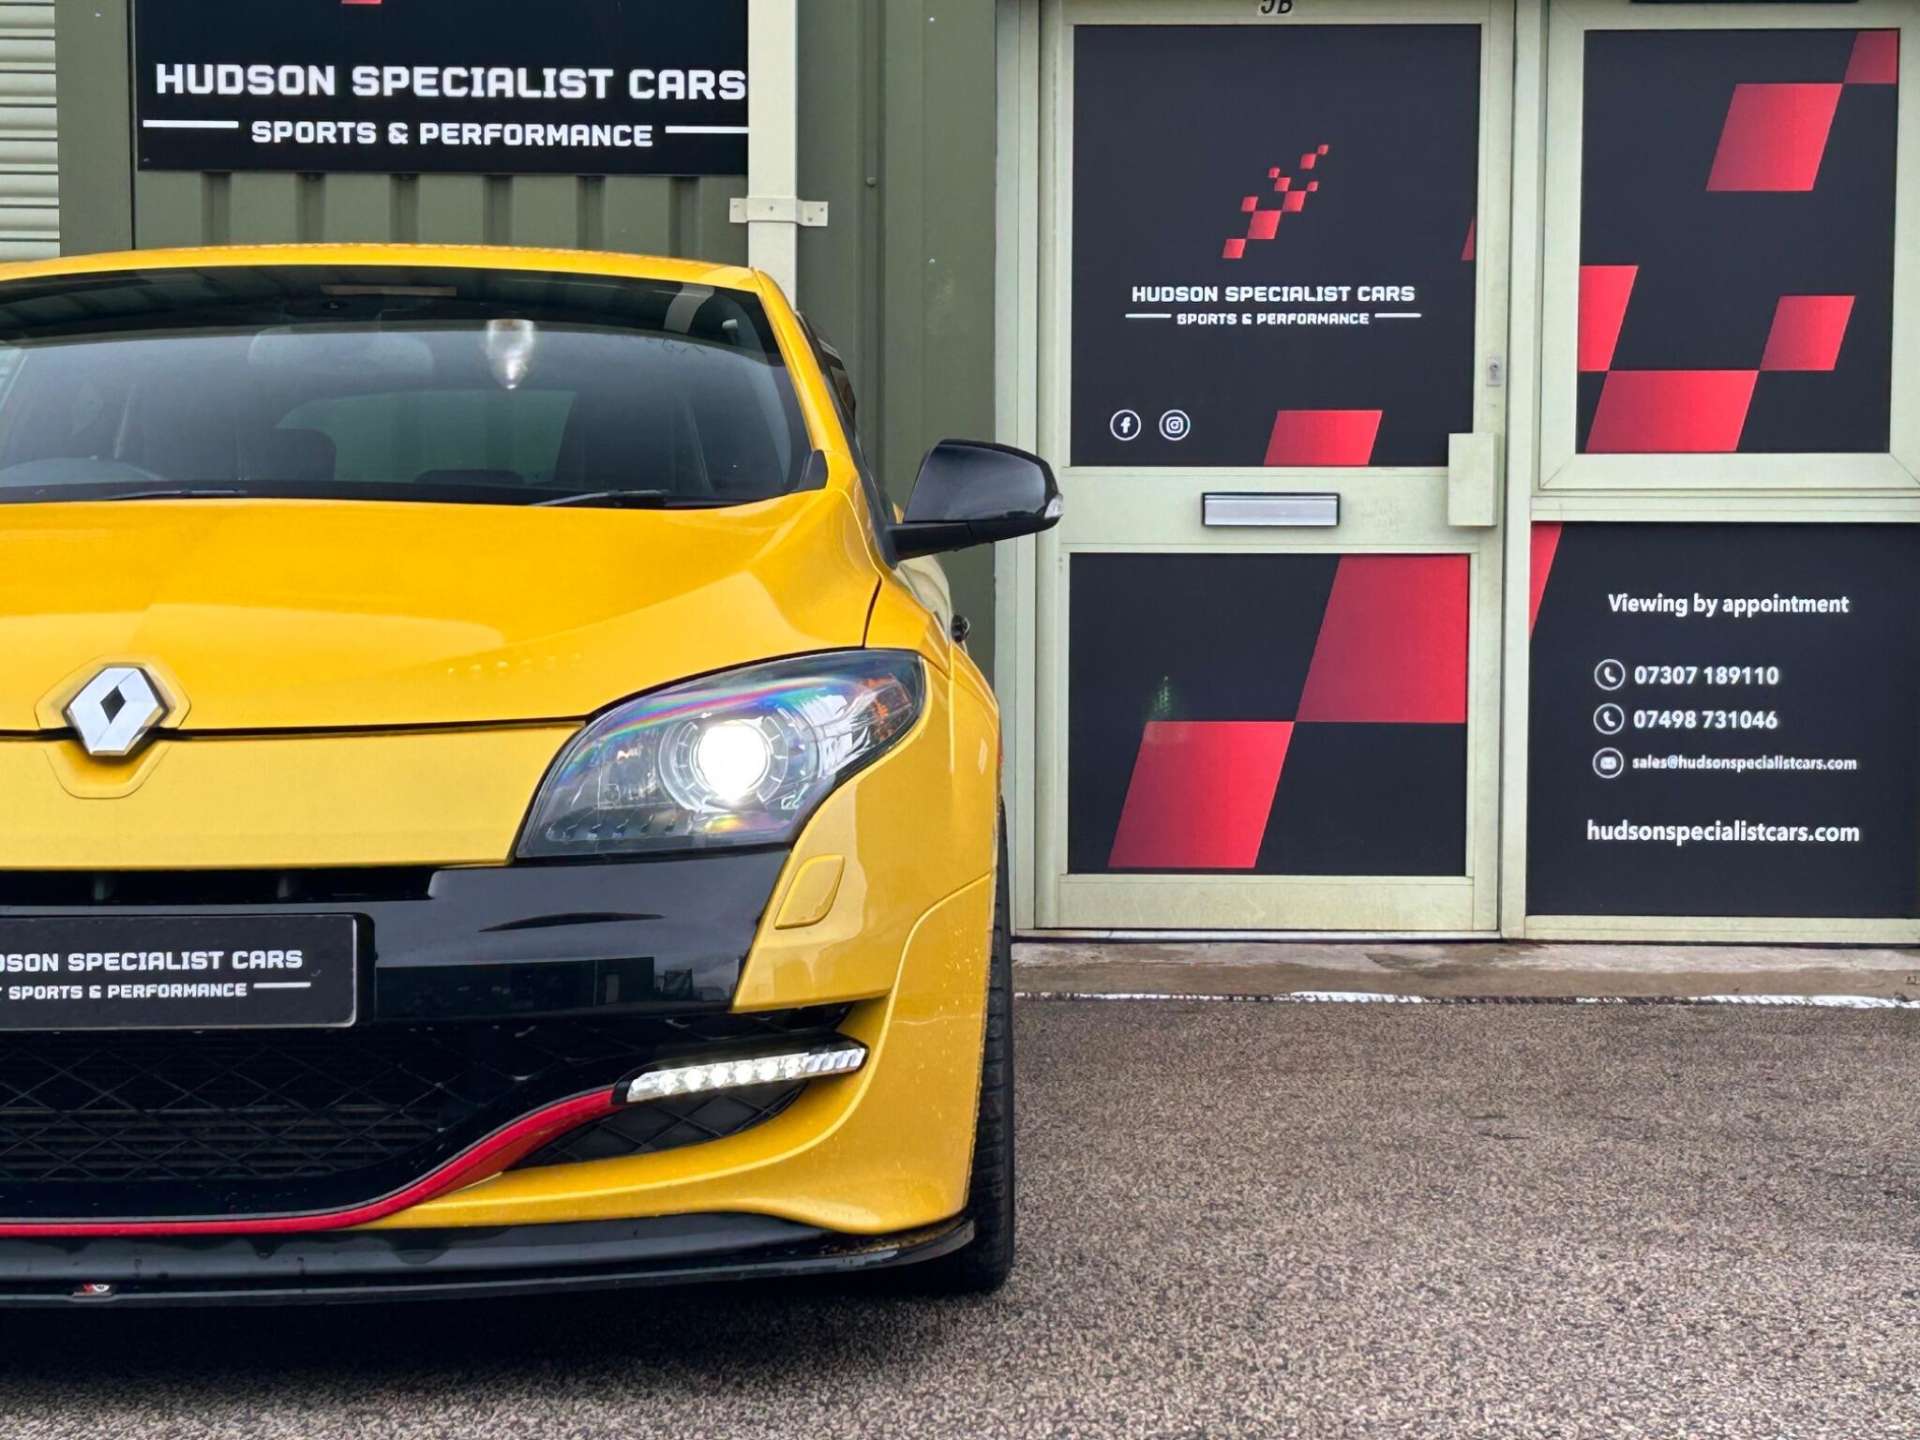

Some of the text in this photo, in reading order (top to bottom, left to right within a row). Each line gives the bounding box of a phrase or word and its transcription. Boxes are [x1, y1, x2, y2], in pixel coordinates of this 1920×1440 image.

[157, 63, 746, 100] HUDSON SPECIALIST CARS
[252, 121, 653, 147] SPORTS & PERFORMANCE
[1132, 286, 1416, 303] HUDSON SPECIALIST CARS
[1176, 312, 1370, 326] SPORTS & PERFORMANCE
[1608, 593, 1849, 619] Viewing by appointment
[1634, 666, 1780, 685] 07307 189110
[1634, 710, 1779, 729] 07498 731046
[1632, 754, 1858, 774] sales@hudsonspecialistcars.com
[1586, 819, 1860, 847] hudsonspecialistcars.com
[68, 950, 225, 971] SPECIALIST
[232, 950, 303, 969] CARS
[9, 982, 248, 1000] SPORTS & PERFORMANCE
